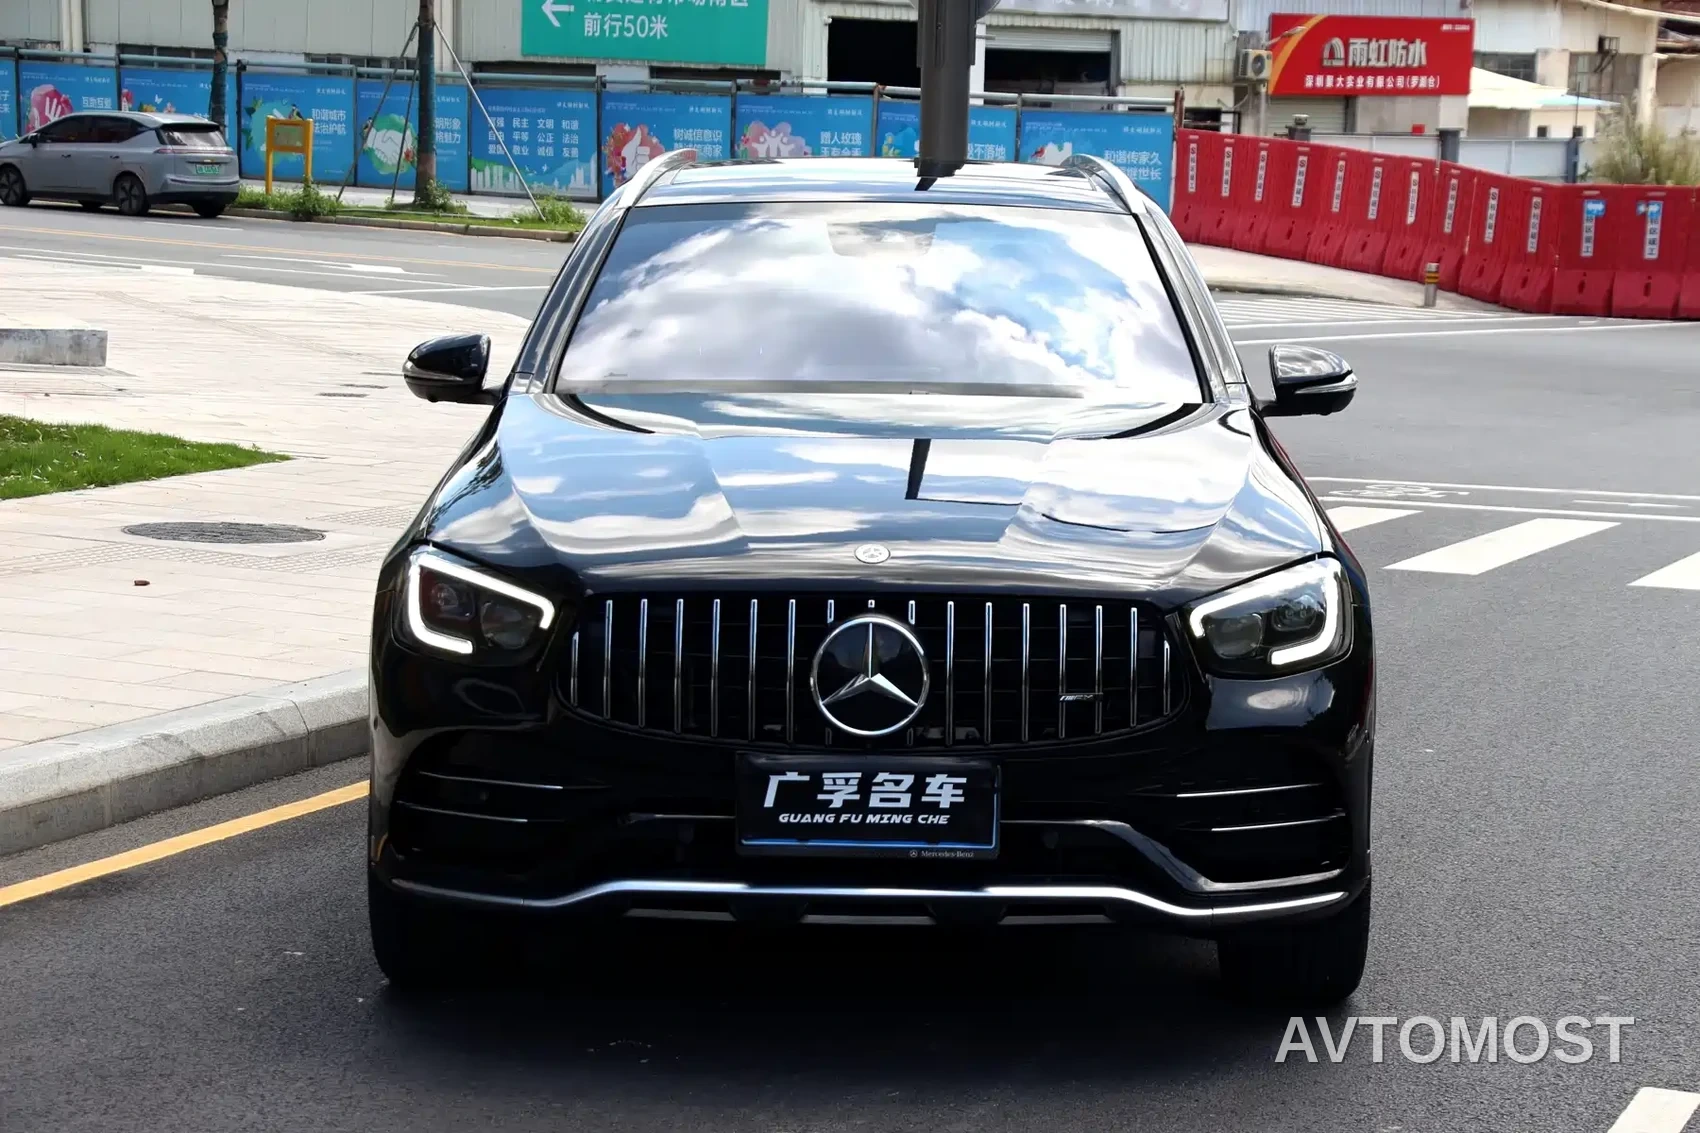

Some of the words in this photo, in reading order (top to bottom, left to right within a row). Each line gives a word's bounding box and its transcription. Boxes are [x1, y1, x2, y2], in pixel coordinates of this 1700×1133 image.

[584, 12, 668, 39] 前行50米
[1349, 37, 1427, 68] 雨虹防水
[311, 108, 346, 121] 和谐城市
[512, 117, 529, 129] 民主
[537, 118, 554, 129] 文明
[562, 119, 579, 130] 和谐
[512, 131, 529, 142] 平等
[537, 132, 554, 143] 公正
[562, 133, 579, 144] 法治
[512, 145, 529, 156] 敬业
[537, 146, 554, 157] 诚信
[562, 147, 579, 158] 友善
[764, 772, 967, 808] 广孚名车
[778, 813, 835, 824] GUANG
[839, 813, 863, 824] FU
[866, 813, 913, 824] MING
[917, 814, 950, 825] CHE
